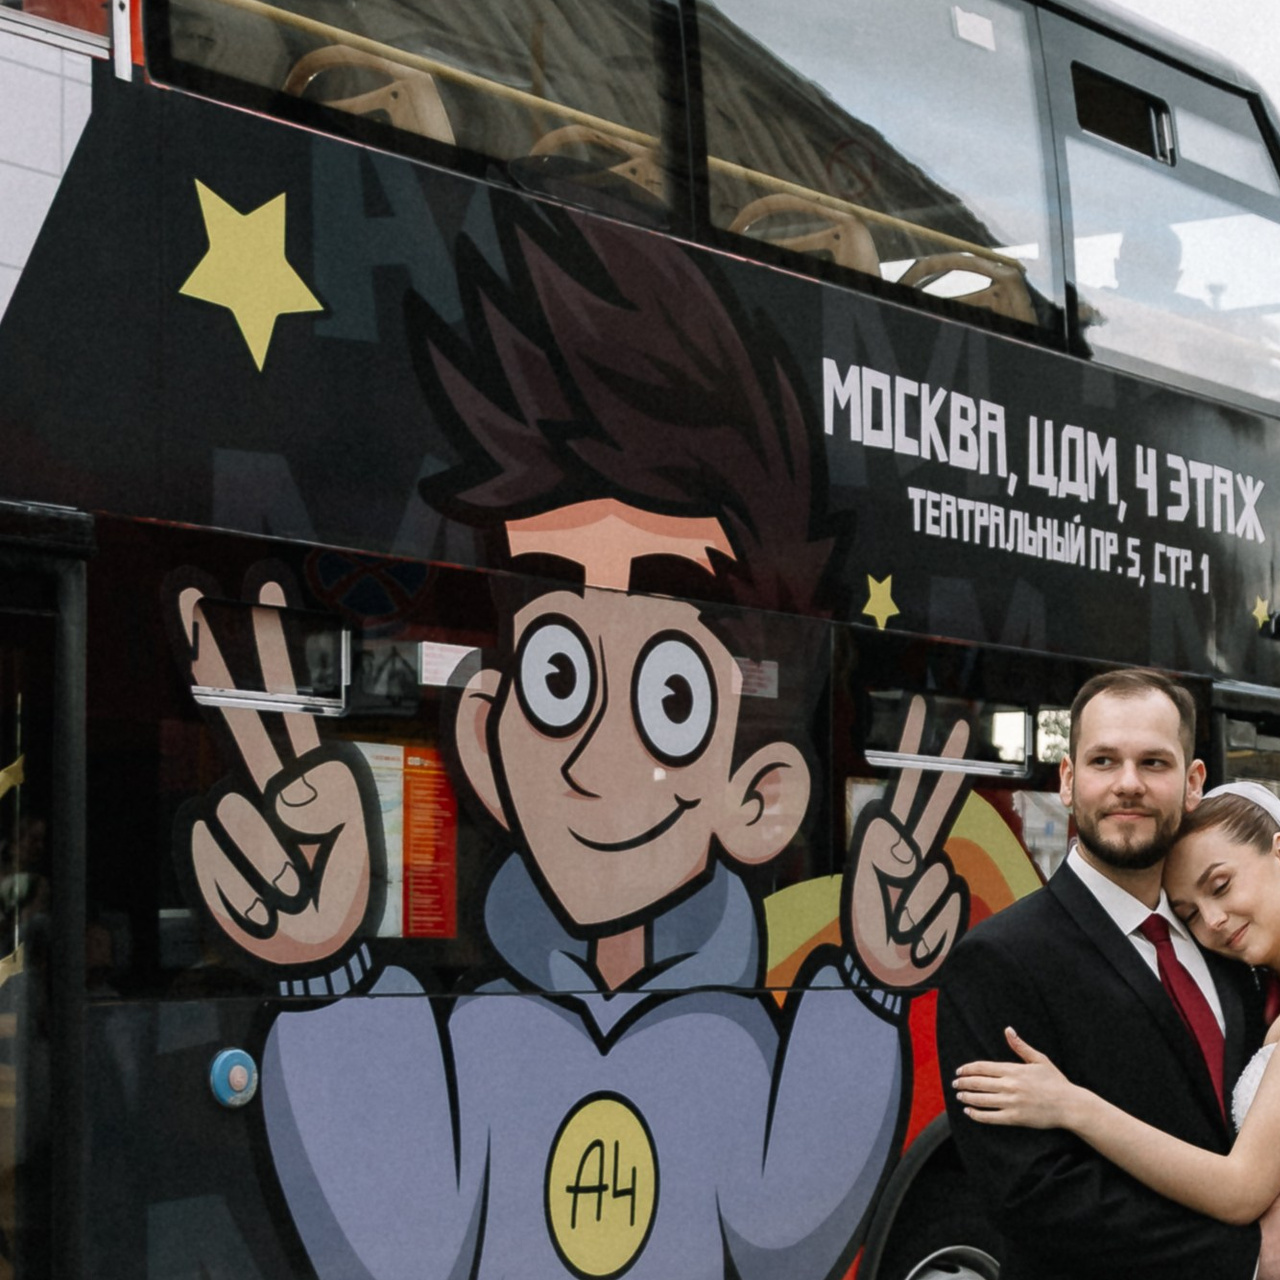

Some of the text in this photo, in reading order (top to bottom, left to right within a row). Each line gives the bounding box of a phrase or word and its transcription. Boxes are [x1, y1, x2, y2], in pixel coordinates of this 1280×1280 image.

[823, 358, 1018, 497] МОСКВА,
[1028, 416, 1127, 523] ЦДМ,
[1166, 453, 1266, 544] ЭТАЖ
[907, 487, 1085, 567] ТЕАТРАЛЬНЫЙ
